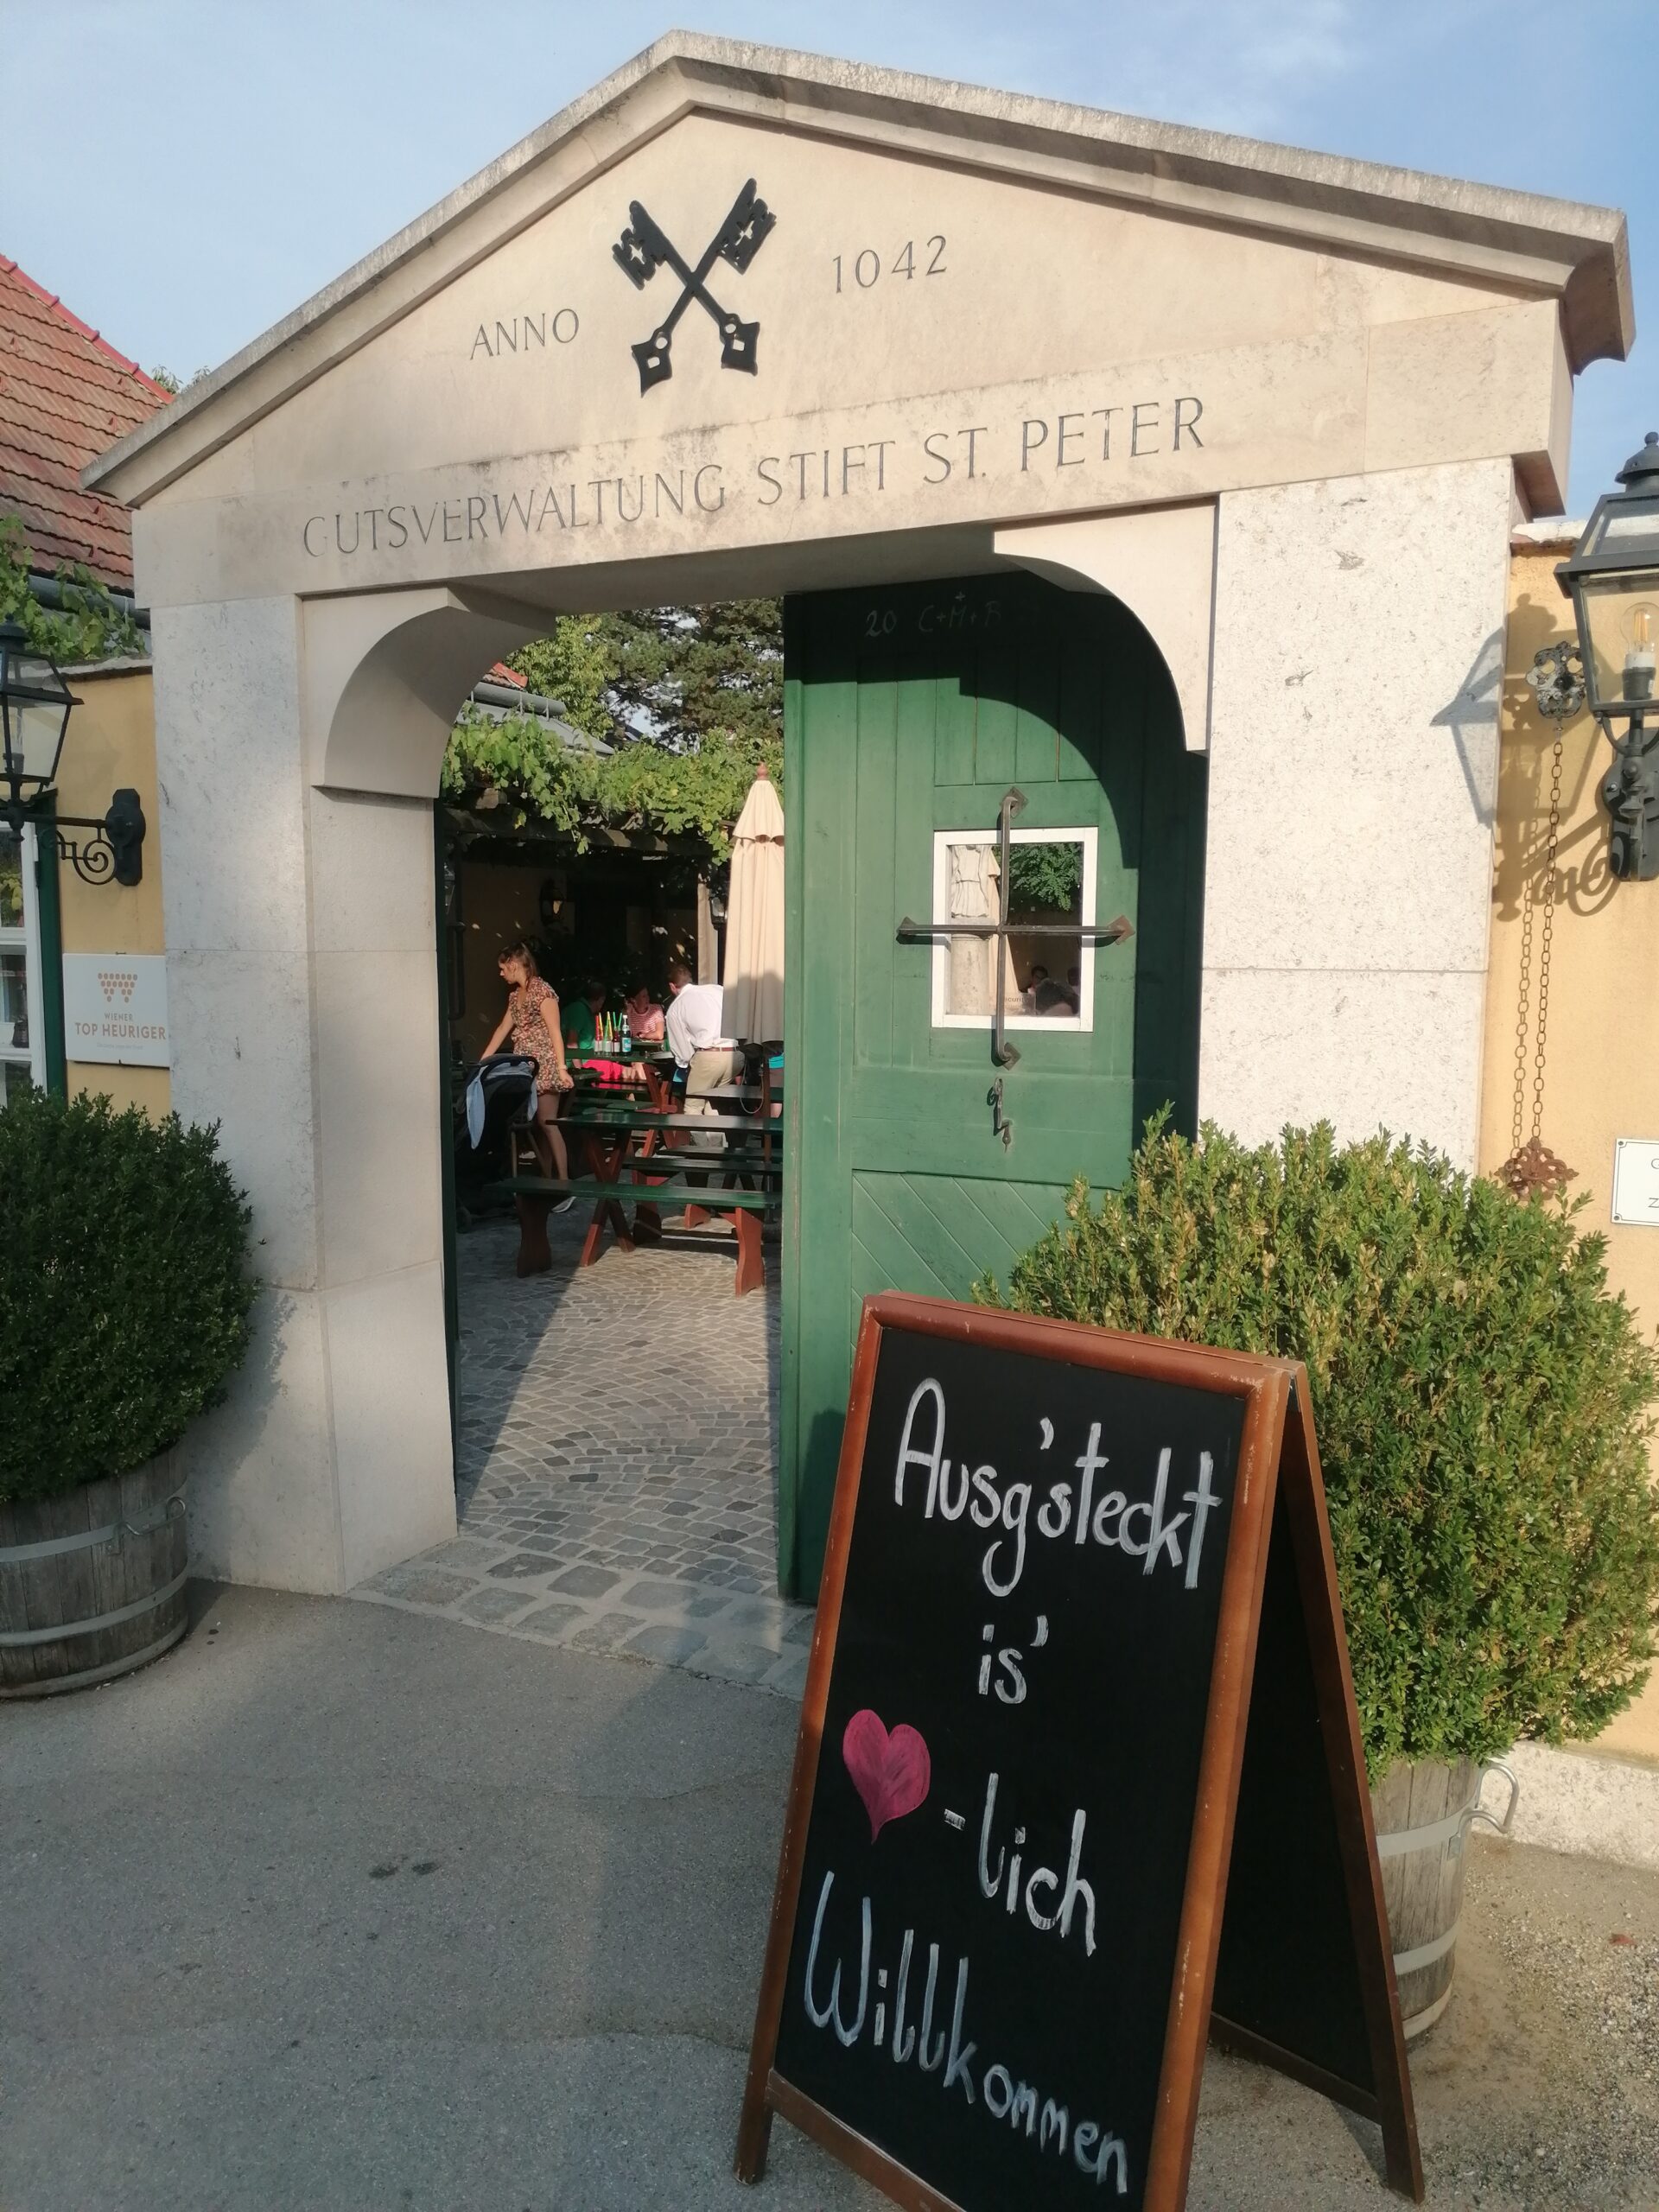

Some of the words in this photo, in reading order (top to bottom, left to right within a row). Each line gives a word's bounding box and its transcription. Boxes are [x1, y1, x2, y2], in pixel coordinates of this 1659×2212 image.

[468, 308, 581, 361] ANNO
[831, 234, 948, 295] 1042
[302, 463, 727, 558] GUTSVERWALTUNG
[756, 440, 897, 506] STIFT
[922, 427, 988, 484] ST.
[1020, 396, 1205, 473] PETER
[865, 608, 898, 637] 20
[75, 1022, 99, 1036] TOP
[102, 1024, 167, 1040] HEURIGER
[105, 1012, 133, 1021] WIENER
[894, 1377, 1223, 1597] Ausg'steckt
[804, 1870, 1128, 2194] Willkommen
